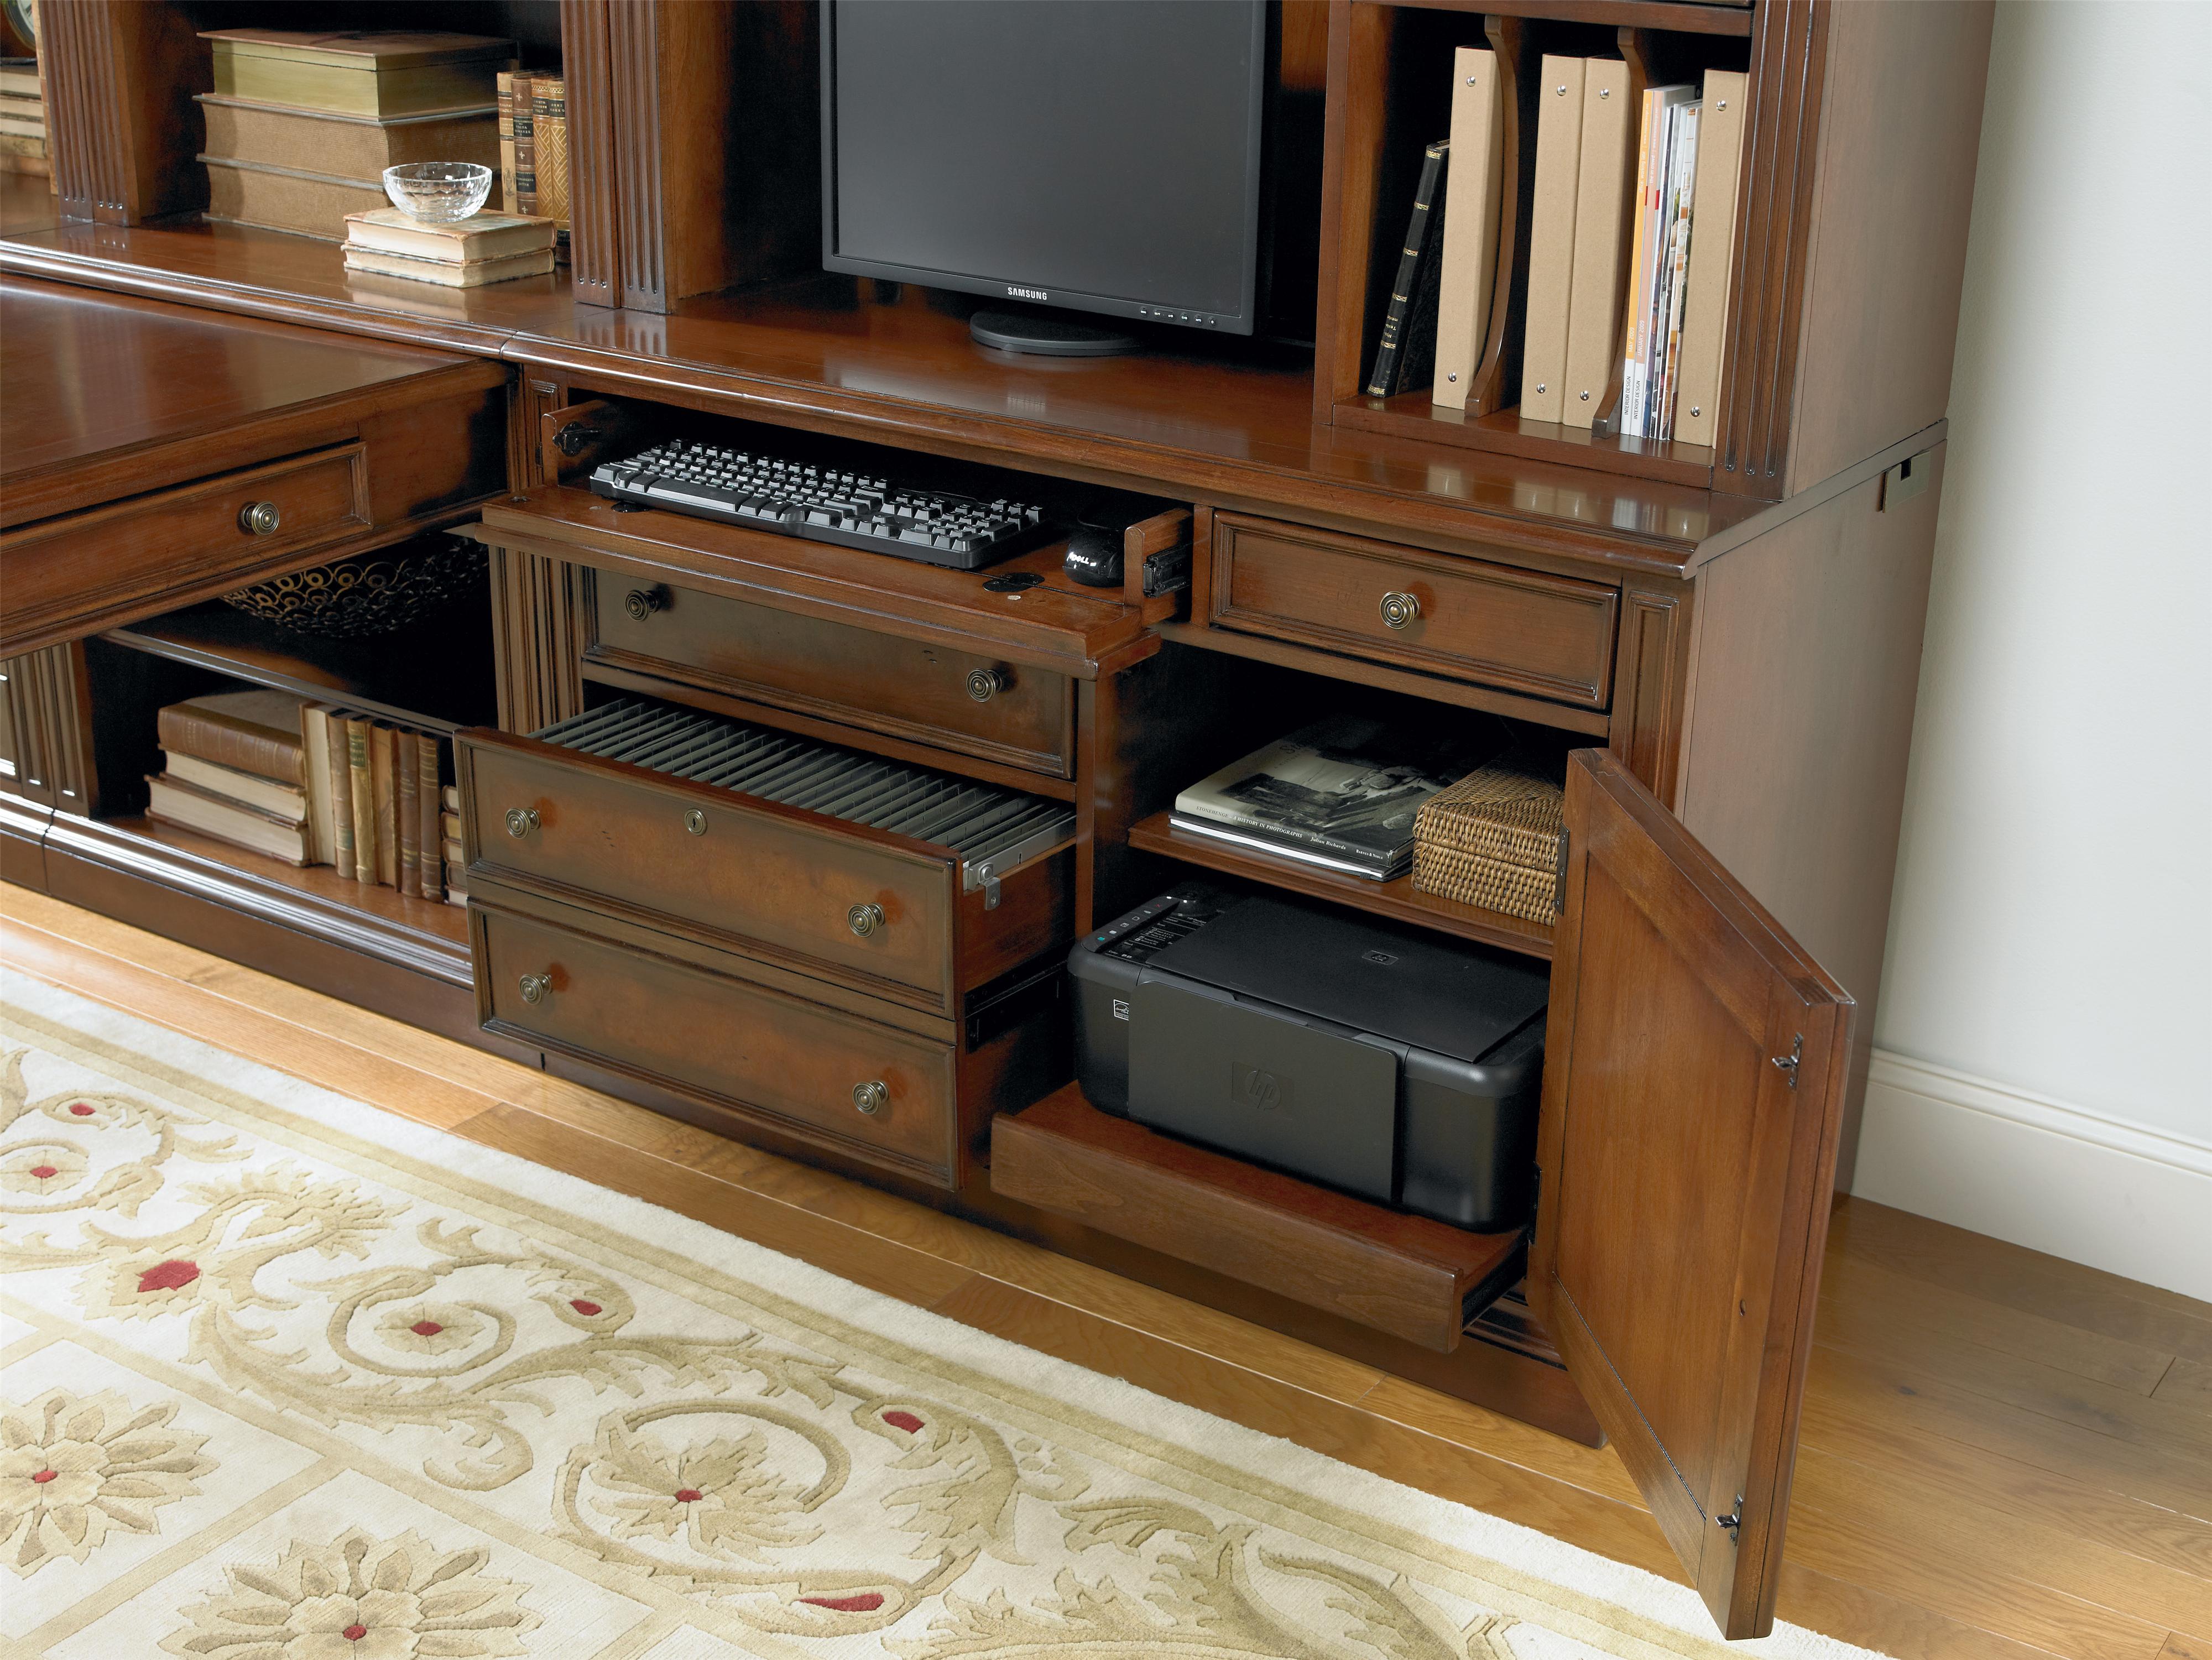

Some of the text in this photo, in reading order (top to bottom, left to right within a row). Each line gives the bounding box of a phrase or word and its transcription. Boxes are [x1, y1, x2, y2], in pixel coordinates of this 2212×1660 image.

[1008, 287, 1047, 300] SAMSUNG
[1196, 806, 1228, 818] STONEHENGE
[1238, 817, 1259, 826] HISTORY
[1266, 824, 1303, 838] PHOTOGRAPHS
[1310, 836, 1346, 850] Julian Richards
[1249, 1069, 1276, 1110] hp
